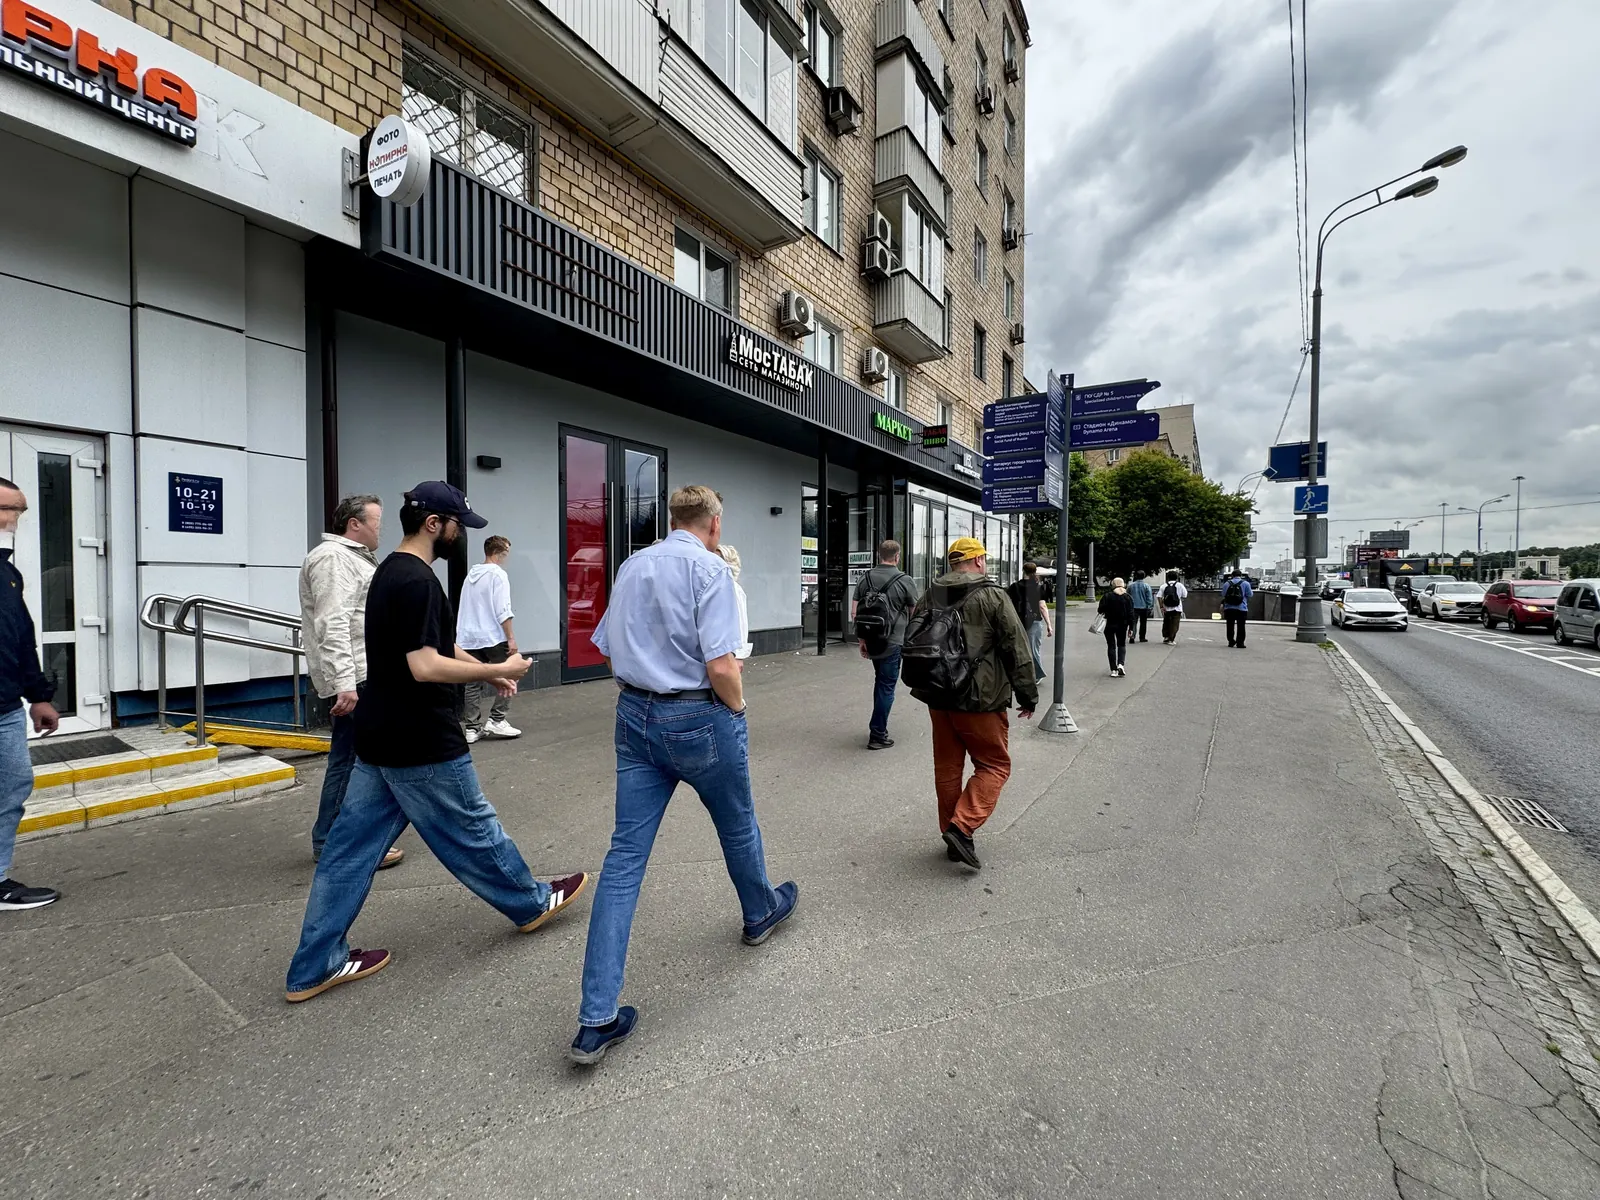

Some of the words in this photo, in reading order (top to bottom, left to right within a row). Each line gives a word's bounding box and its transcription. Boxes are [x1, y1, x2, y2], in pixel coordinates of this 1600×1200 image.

[110, 93, 195, 140] ЦЕНТР
[377, 129, 399, 145] ФОТО
[369, 144, 407, 169] КОПИРКА
[374, 169, 402, 188] ПЕЧАТЬ
[738, 356, 758, 372] СЕТЬ
[761, 366, 804, 392] МАГАЗИНОВ
[875, 412, 913, 442] МАРКЕТ
[1083, 422, 1106, 430] Стадион
[1083, 428, 1104, 436] Dynamo
[924, 437, 946, 446] ПИВО
[175, 486, 216, 500] 10-21
[180, 501, 215, 511] 10-19
[802, 556, 816, 567] СИДР
